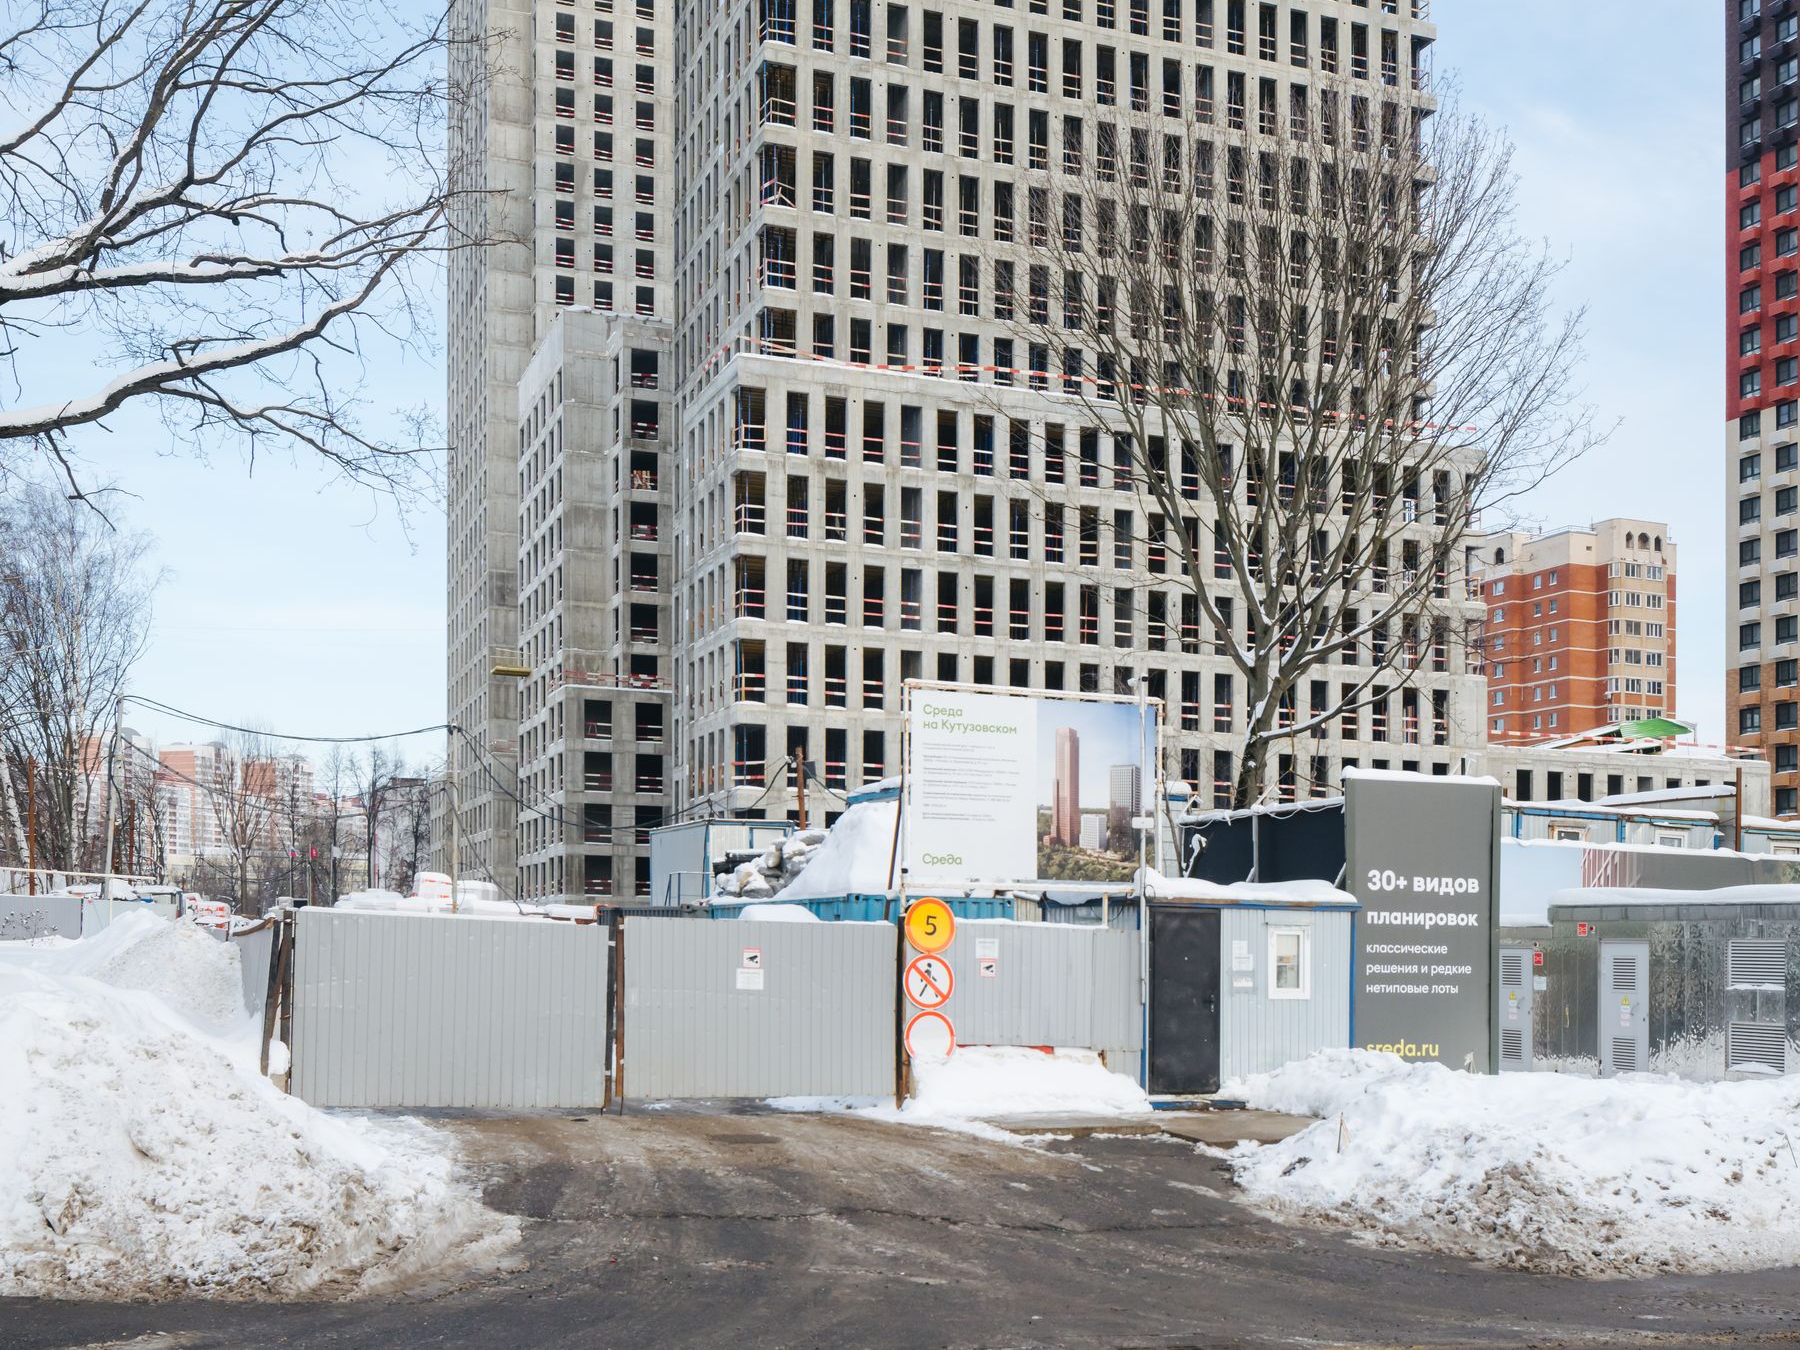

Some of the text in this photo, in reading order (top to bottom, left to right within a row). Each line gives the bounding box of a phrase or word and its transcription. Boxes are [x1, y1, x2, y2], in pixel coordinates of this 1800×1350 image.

[922, 703, 963, 718] Среда
[923, 719, 1017, 734] на Кутузовском
[922, 853, 962, 866] Среда
[1367, 869, 1480, 896] 30+ видов
[925, 915, 937, 936] 5
[1367, 911, 1479, 930] планировок
[1366, 944, 1448, 954] классические
[1366, 964, 1472, 976] решения и редкие
[1366, 984, 1459, 994] нетиповые лоты
[1366, 1038, 1439, 1057] sreda.ru
